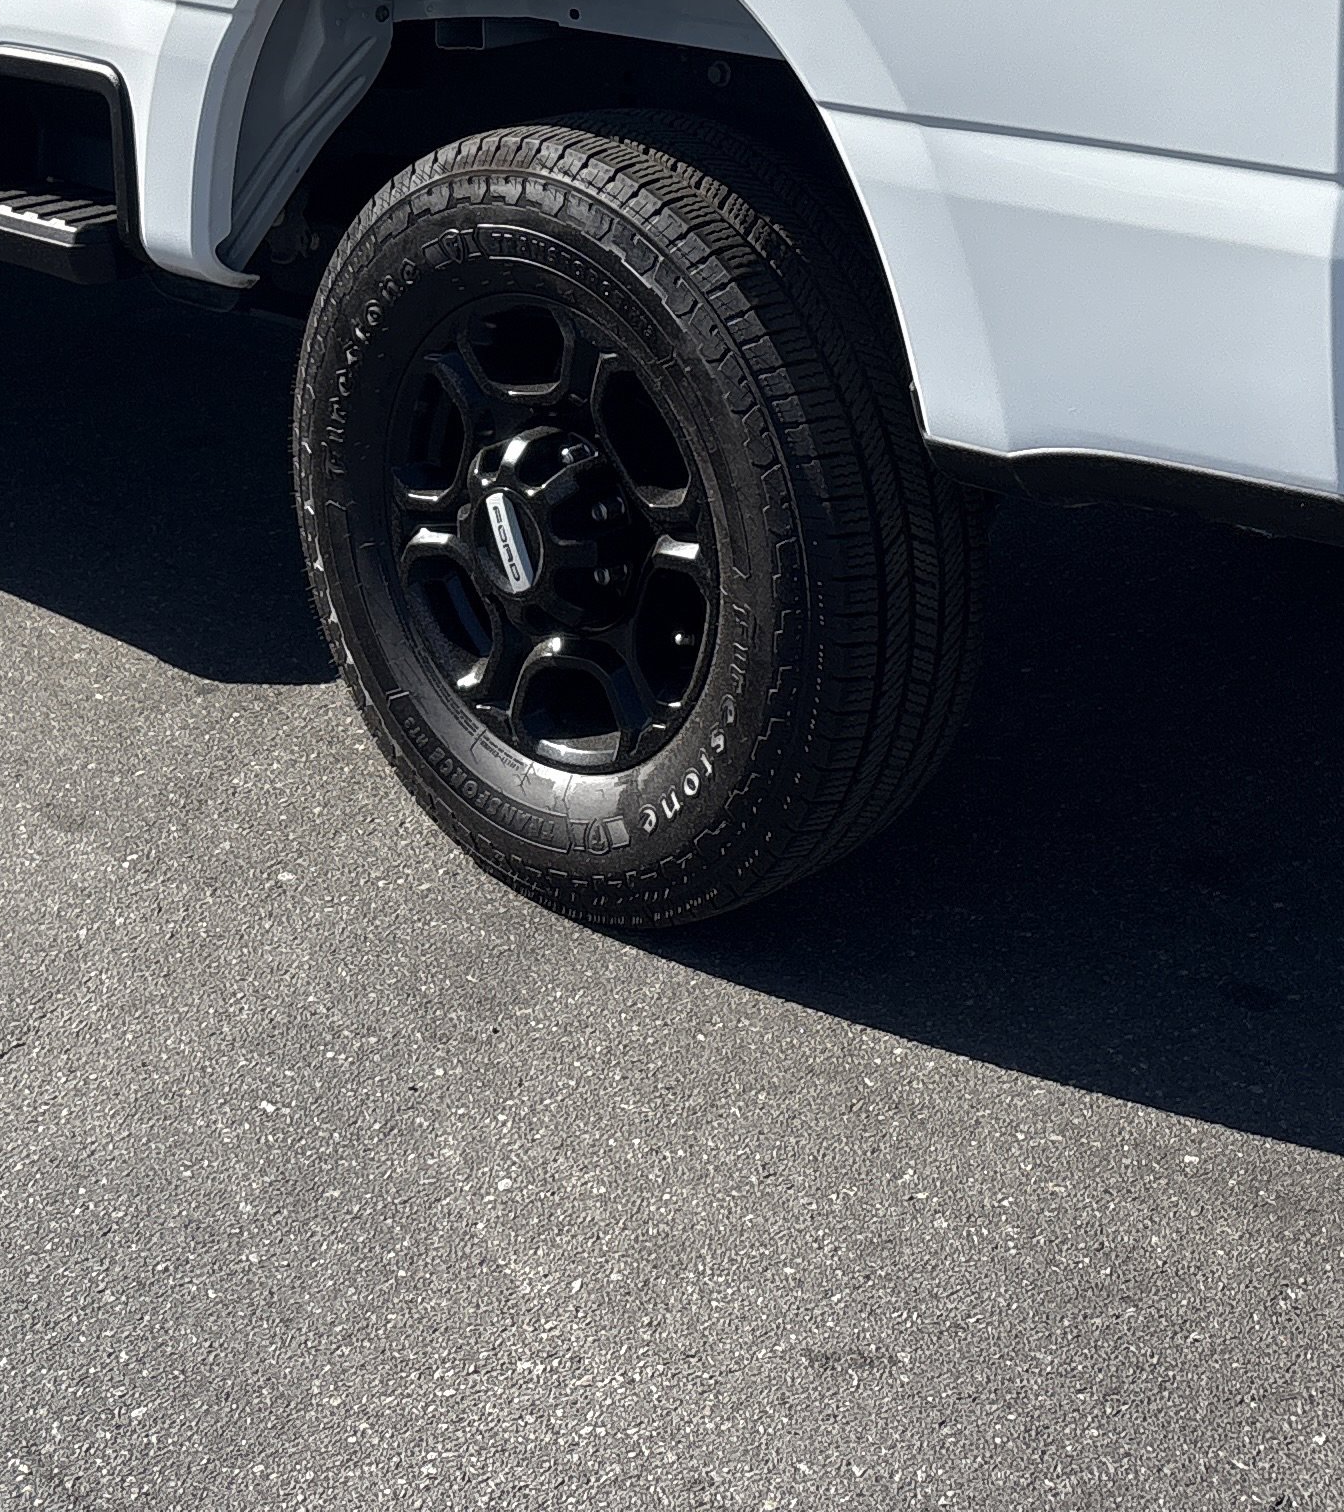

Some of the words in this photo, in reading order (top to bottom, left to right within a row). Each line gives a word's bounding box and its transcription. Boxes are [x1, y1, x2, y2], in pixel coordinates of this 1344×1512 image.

[492, 505, 521, 582] FORD
[639, 602, 754, 836] Firestone
[428, 747, 558, 840] TRANSFORCE
